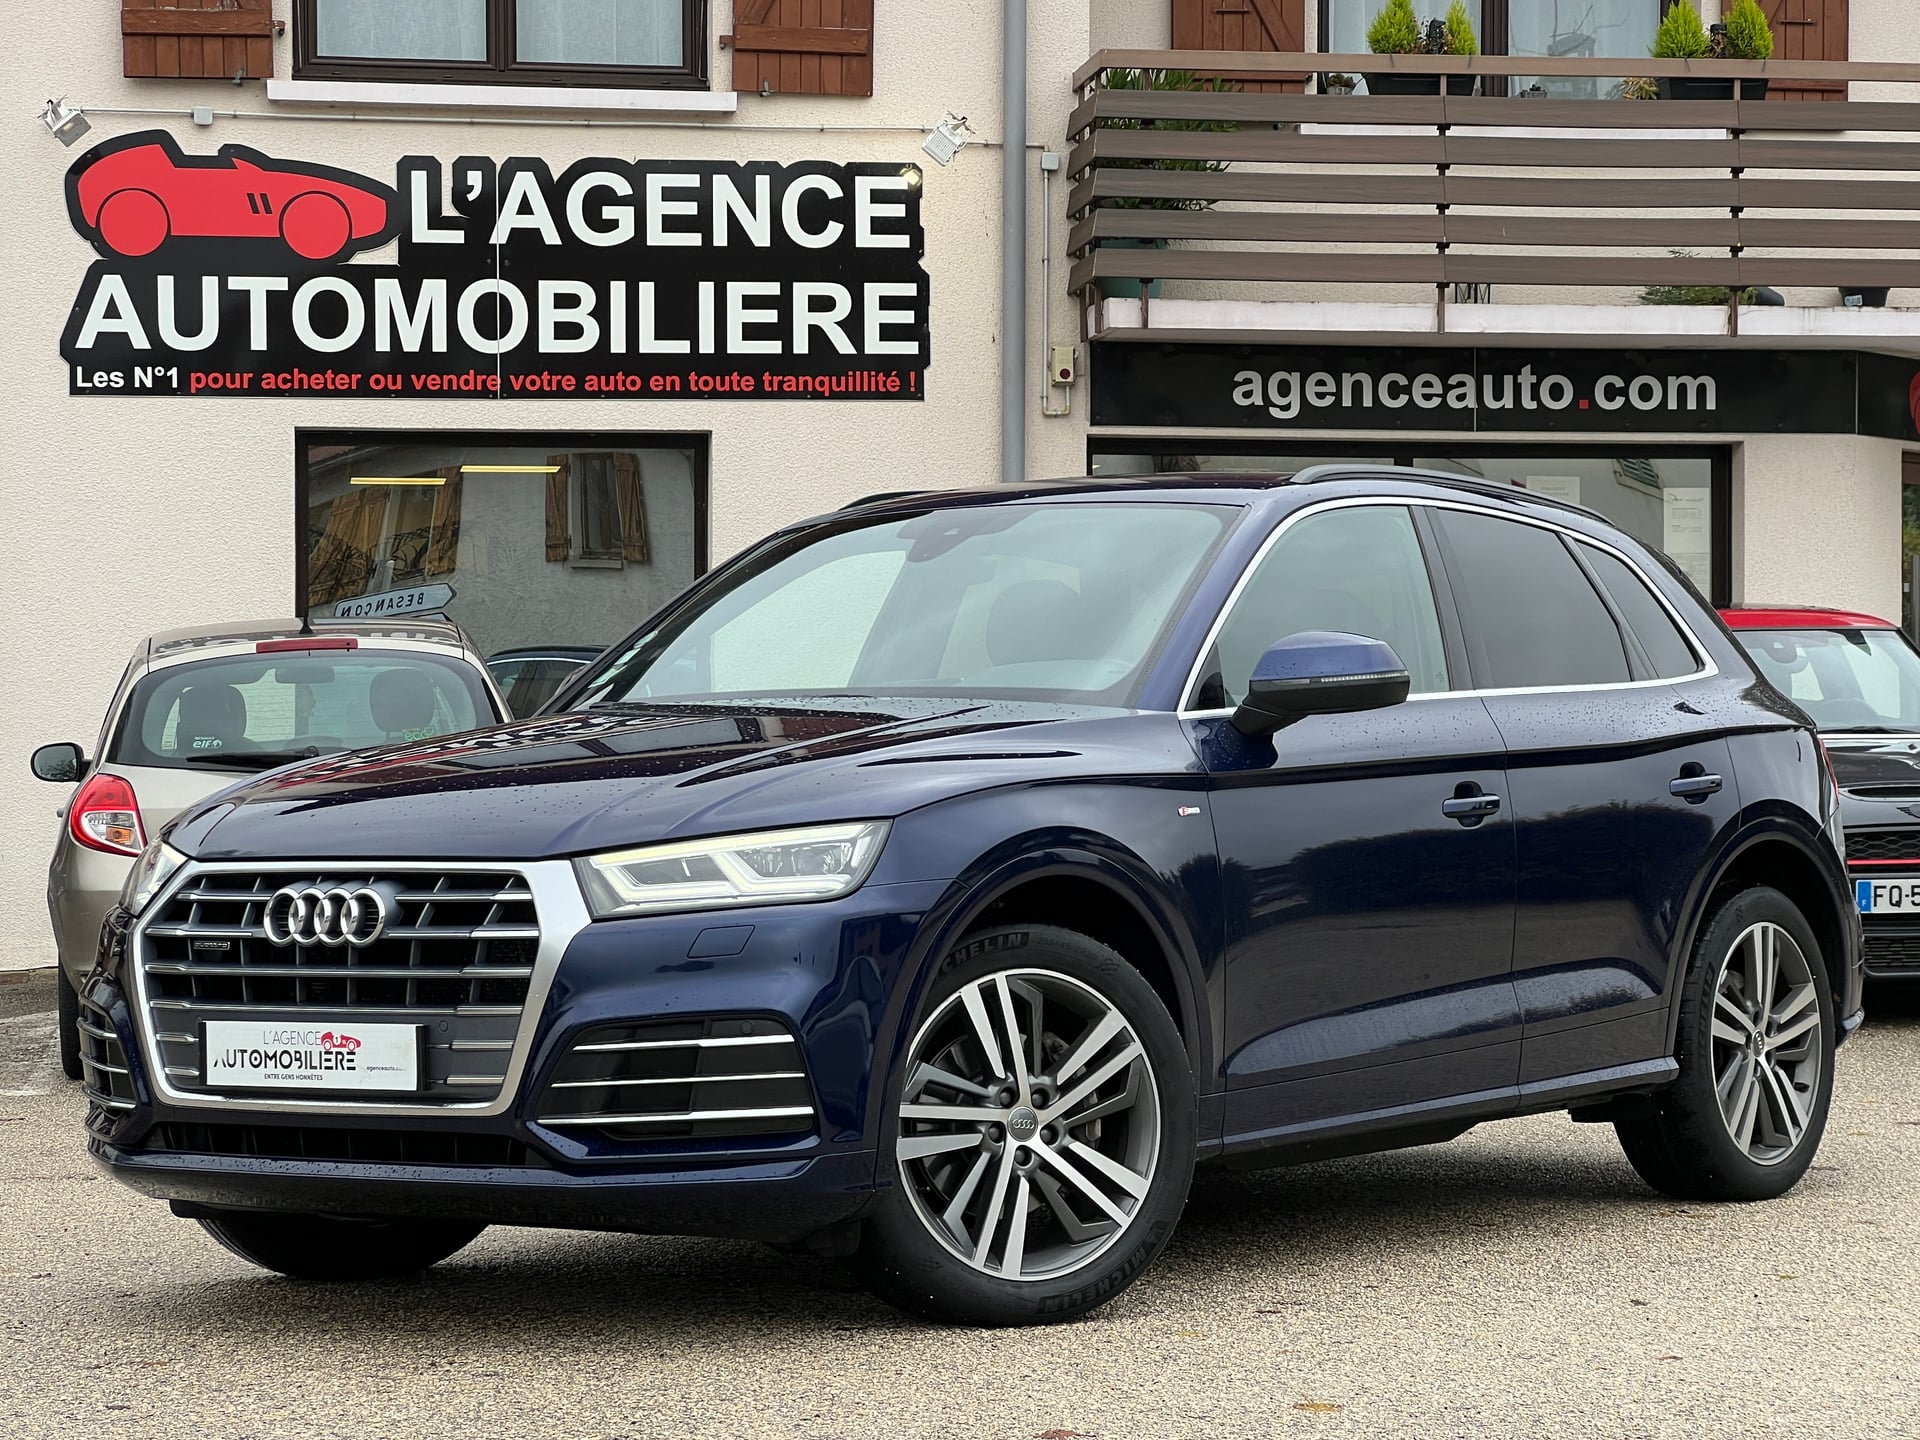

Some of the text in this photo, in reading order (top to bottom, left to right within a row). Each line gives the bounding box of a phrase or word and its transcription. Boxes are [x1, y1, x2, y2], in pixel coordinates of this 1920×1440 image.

[411, 170, 912, 248] L'AGENCE
[75, 275, 919, 355] AUTOMOBILIERE
[77, 366, 916, 396] Les N°1 pour acheter ou vendre votre auto en toute tranquillité !
[1232, 364, 1717, 419] agenceauto.com
[942, 932, 1023, 972] CHELIN
[263, 1030, 321, 1046] L'AGENCE
[213, 1048, 356, 1071] AUTOMOBILIERE
